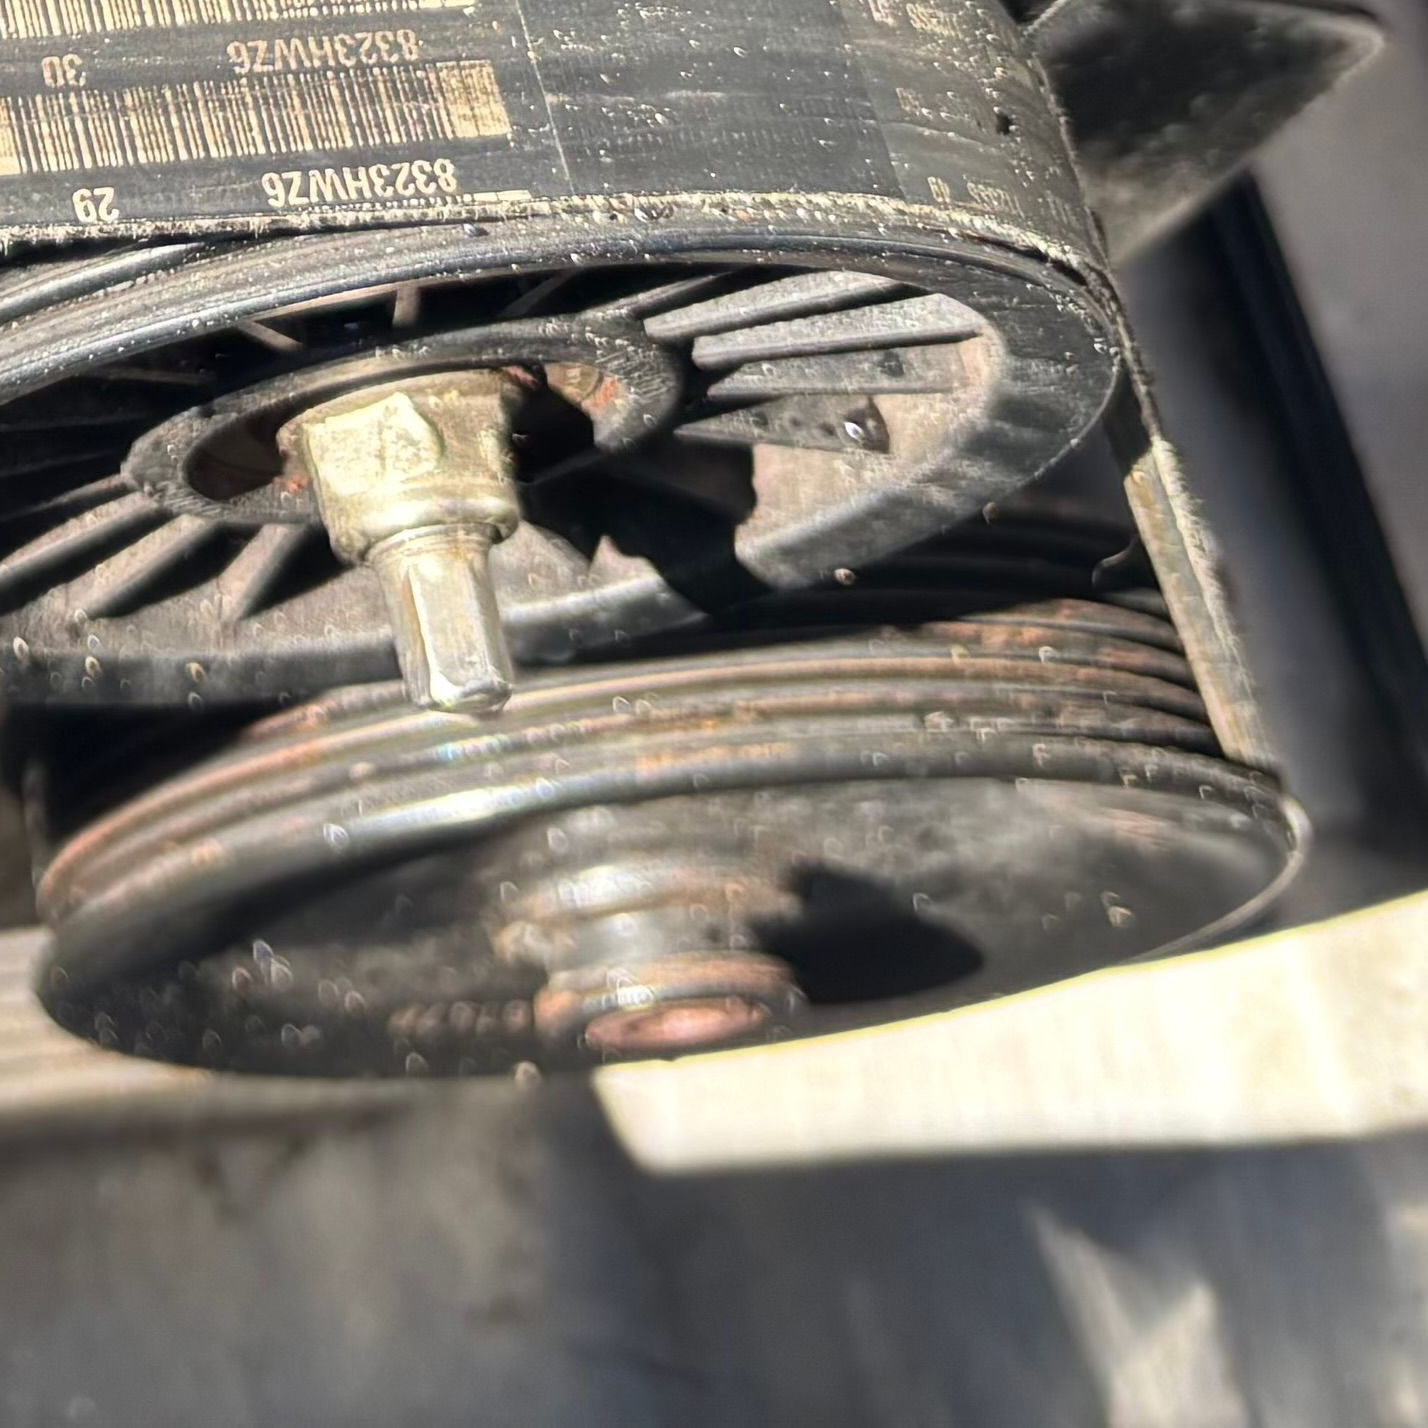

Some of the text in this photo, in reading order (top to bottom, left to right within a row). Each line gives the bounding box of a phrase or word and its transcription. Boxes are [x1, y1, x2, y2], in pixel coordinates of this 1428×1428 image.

[40, 28, 420, 89] 8323HWZ6 30
[71, 156, 457, 223] 8323HWZ6 29
